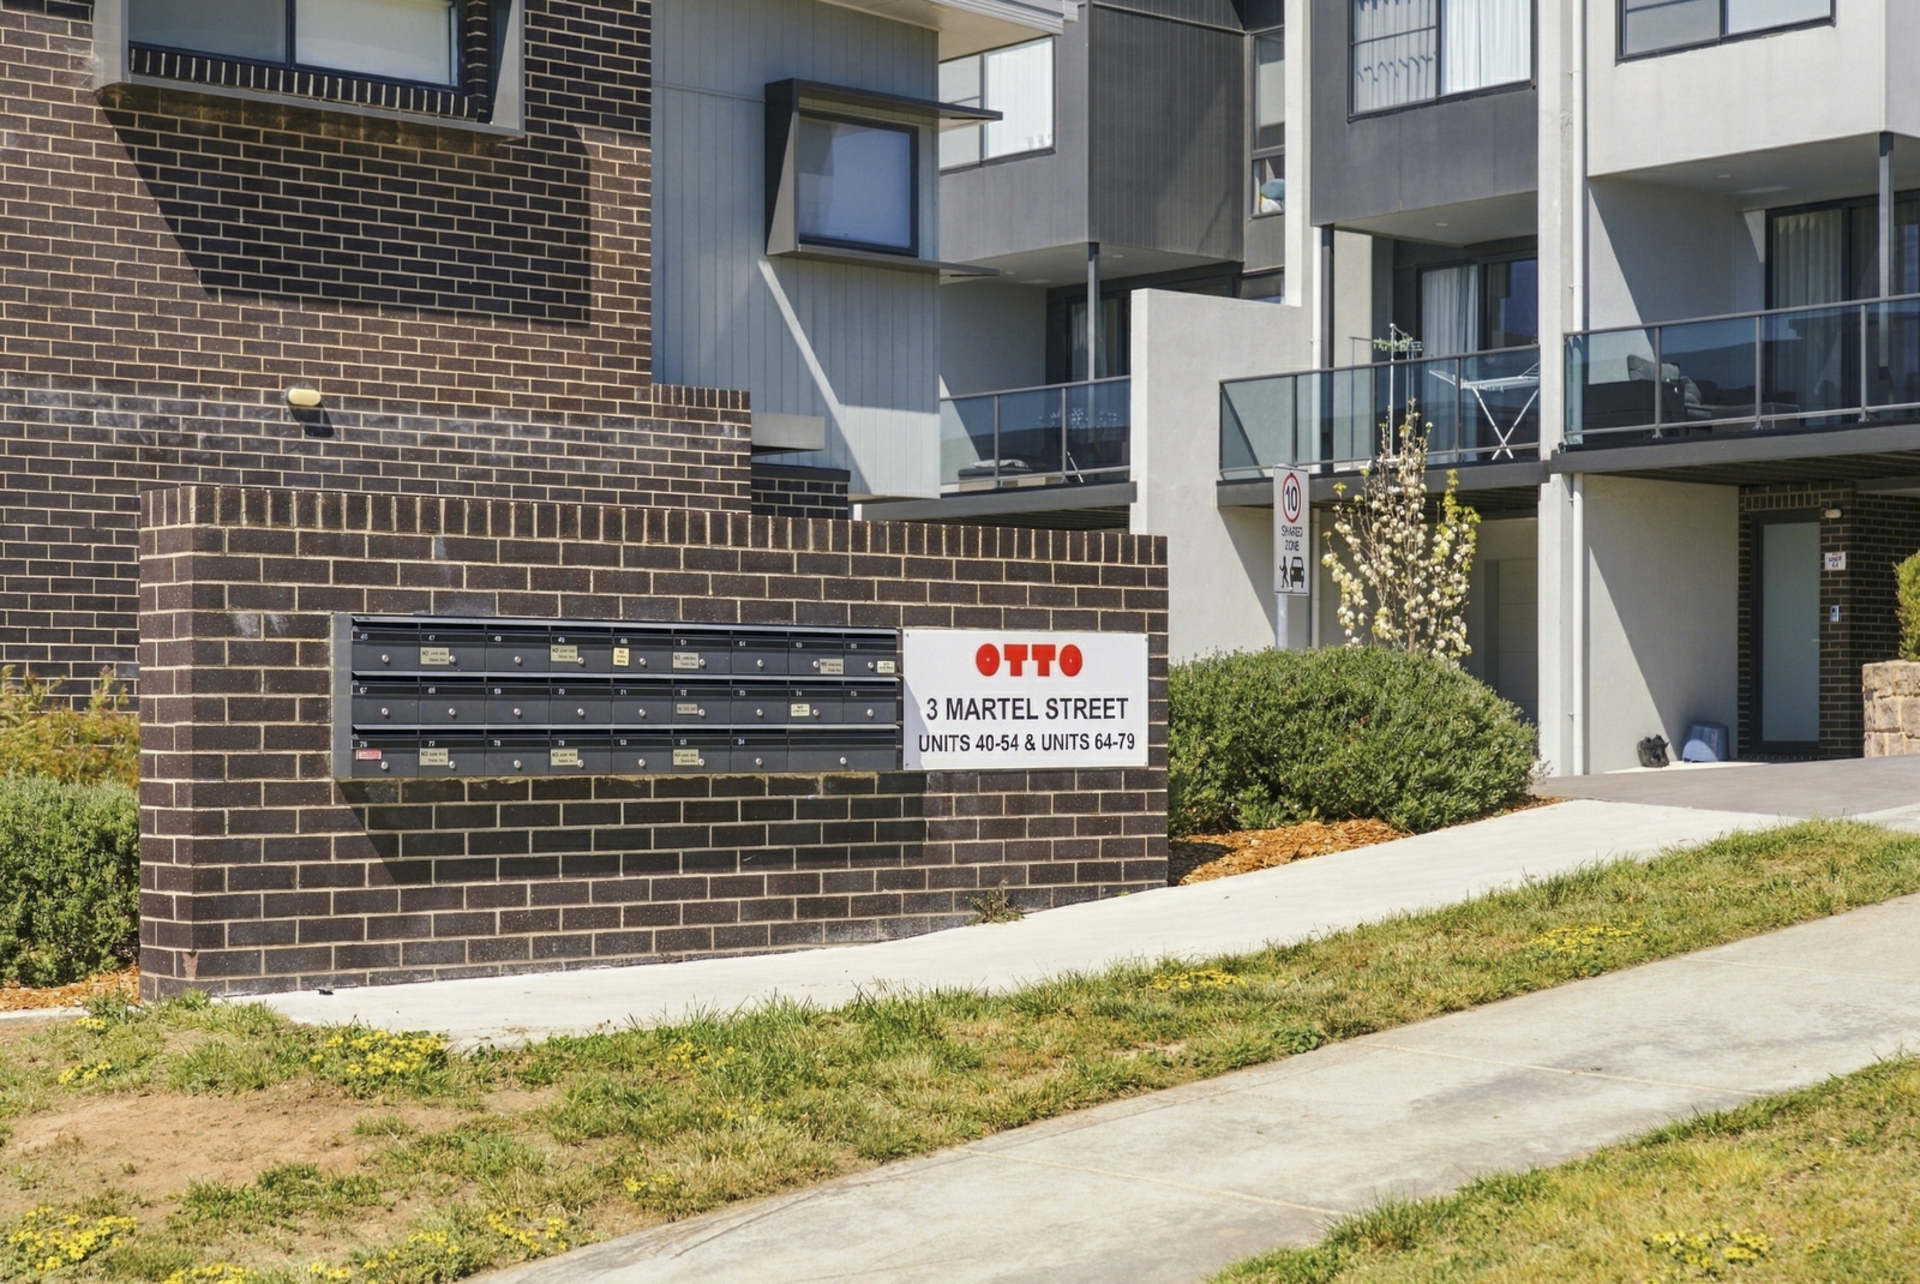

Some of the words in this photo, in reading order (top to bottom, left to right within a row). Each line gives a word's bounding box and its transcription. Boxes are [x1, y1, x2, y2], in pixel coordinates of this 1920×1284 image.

[1285, 485, 1298, 512] 10
[1281, 525, 1303, 538] SHARED
[1285, 540, 1300, 552] ZONE
[975, 643, 1083, 677] OTTO
[926, 698, 938, 721] 3
[945, 698, 1039, 721] MARTEL
[1045, 697, 1129, 720] STREET
[918, 734, 971, 753] UNITS
[975, 734, 1020, 752] 40-54
[1024, 733, 1036, 751] &
[1041, 733, 1090, 751] UNITS
[1094, 732, 1136, 750] 64-79
